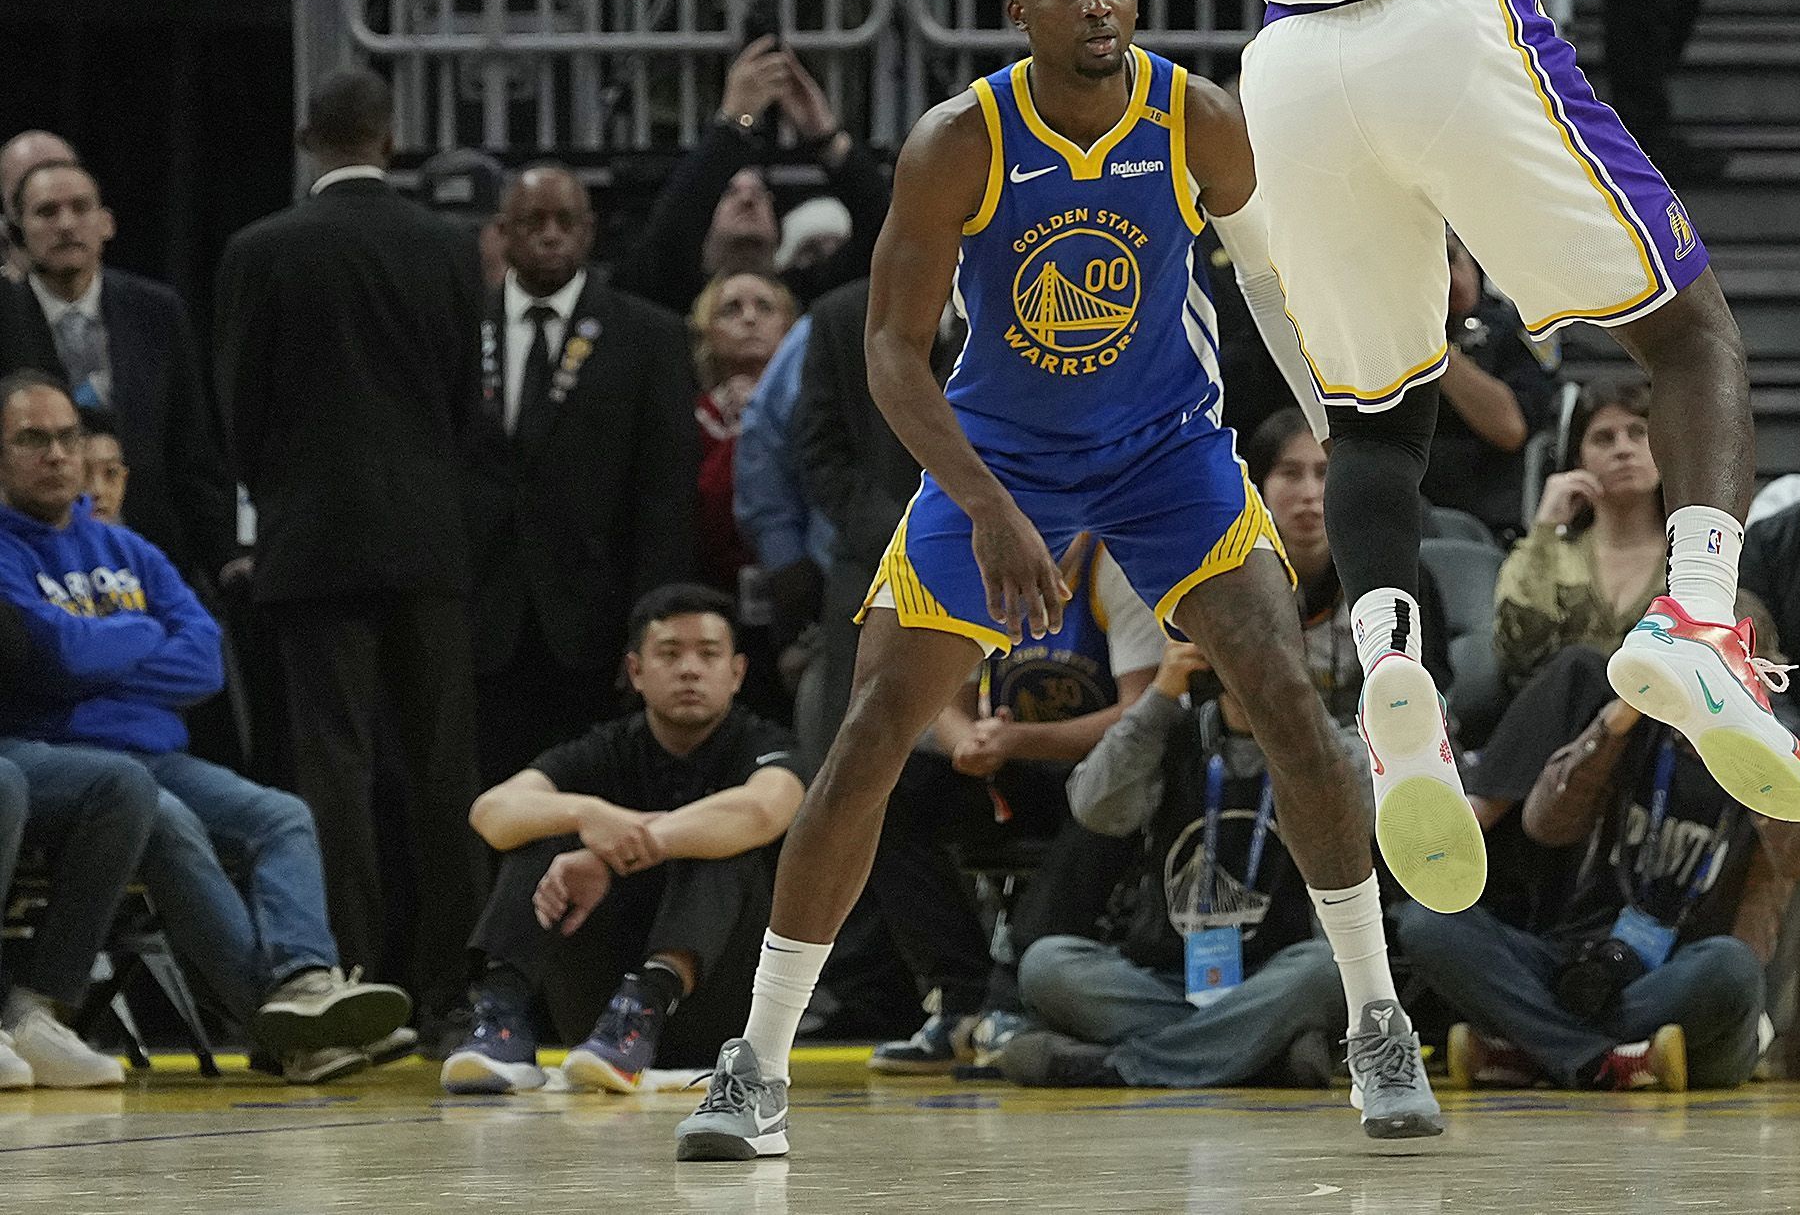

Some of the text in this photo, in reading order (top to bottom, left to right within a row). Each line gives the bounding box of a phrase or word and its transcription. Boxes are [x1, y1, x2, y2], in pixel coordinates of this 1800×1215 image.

[1110, 159, 1165, 176] Rakuten
[1012, 208, 1149, 253] GOLDEN STATE
[1085, 257, 1129, 293] 00
